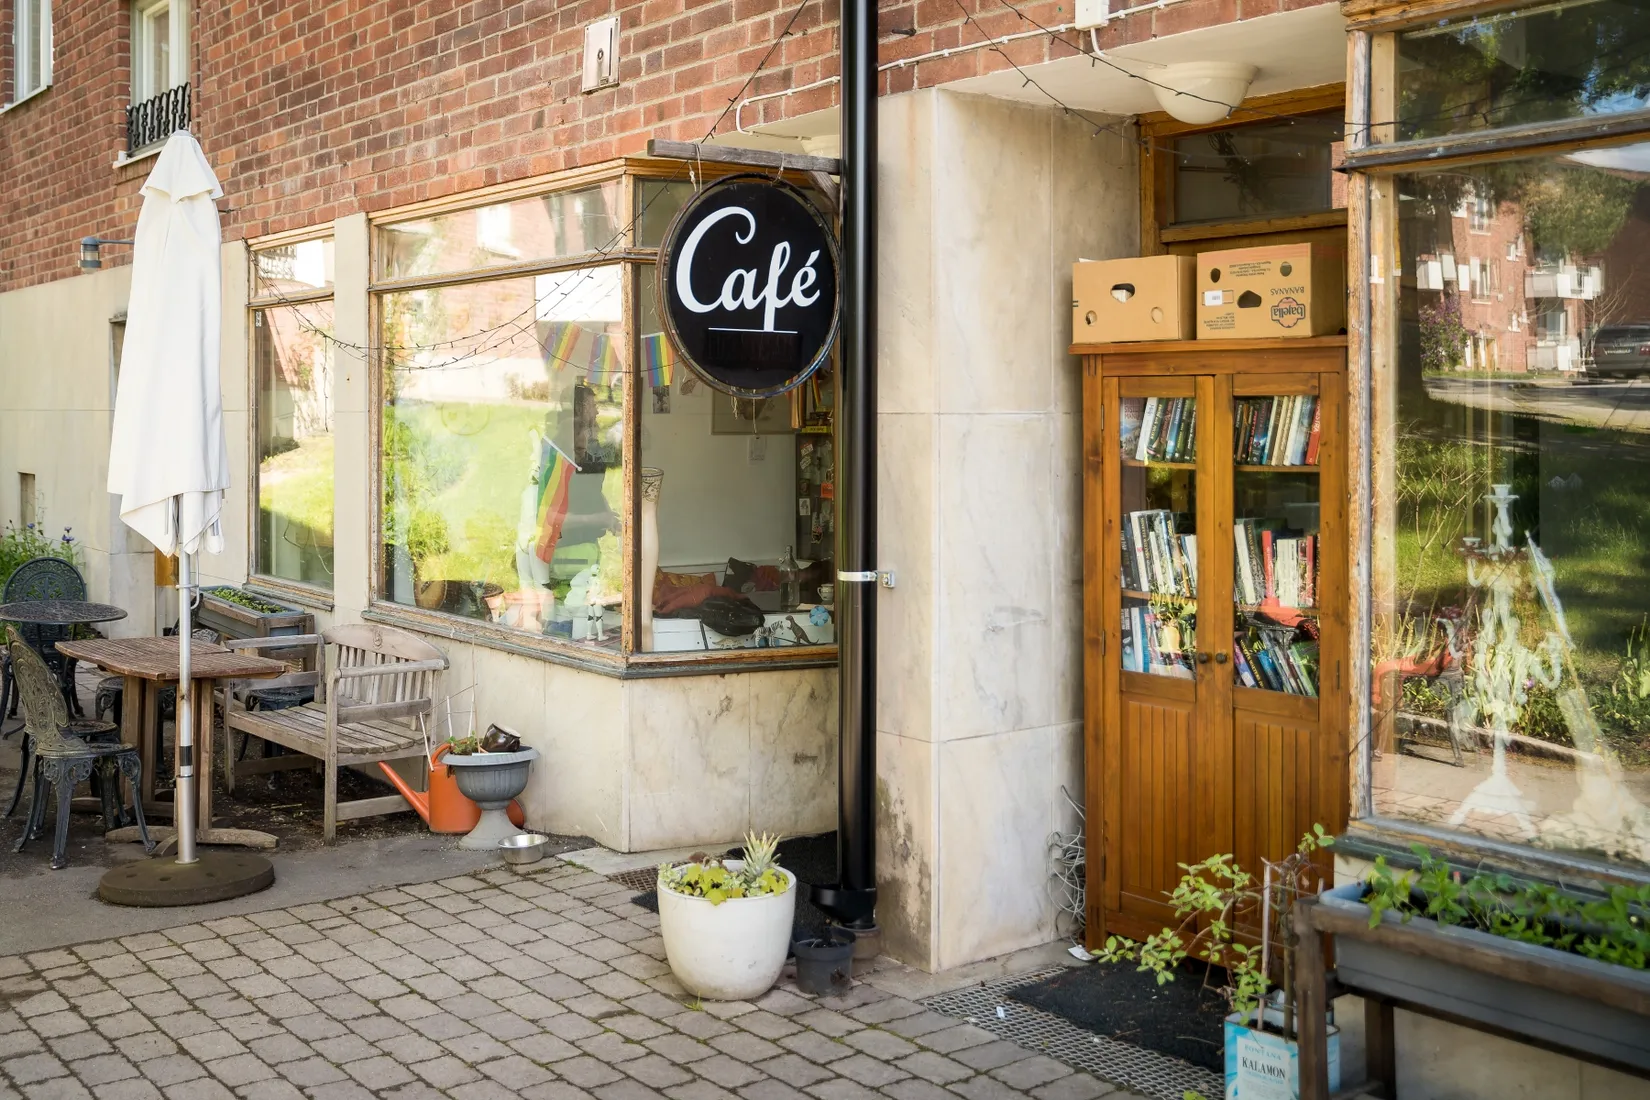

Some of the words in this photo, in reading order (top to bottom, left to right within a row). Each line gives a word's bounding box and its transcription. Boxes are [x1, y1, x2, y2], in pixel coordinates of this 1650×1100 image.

[676, 206, 821, 332] Café
[1270, 286, 1304, 295] BANANAS
[1273, 305, 1303, 318] bajella
[1242, 1056, 1286, 1080] KALAMON
